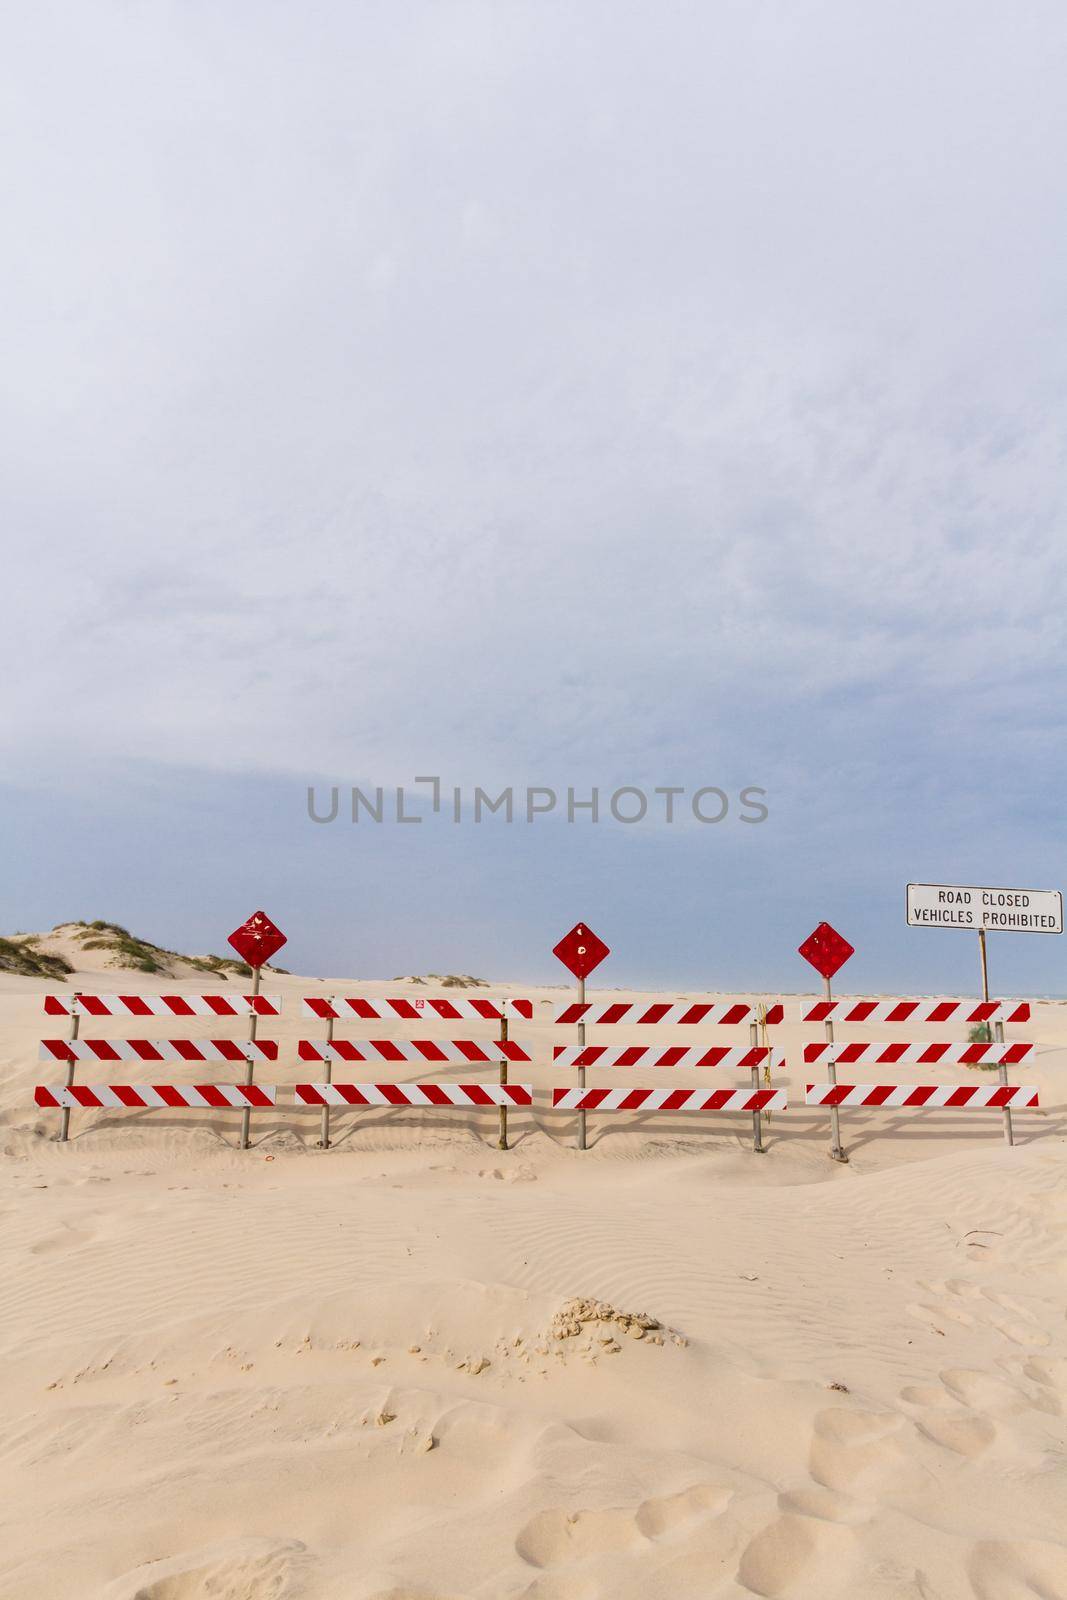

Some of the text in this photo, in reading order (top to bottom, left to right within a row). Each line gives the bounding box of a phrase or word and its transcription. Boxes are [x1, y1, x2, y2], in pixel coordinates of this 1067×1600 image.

[938, 890, 1030, 907] ROAD CLOSED
[914, 908, 1056, 928] VEHICLES PROHIBITED
